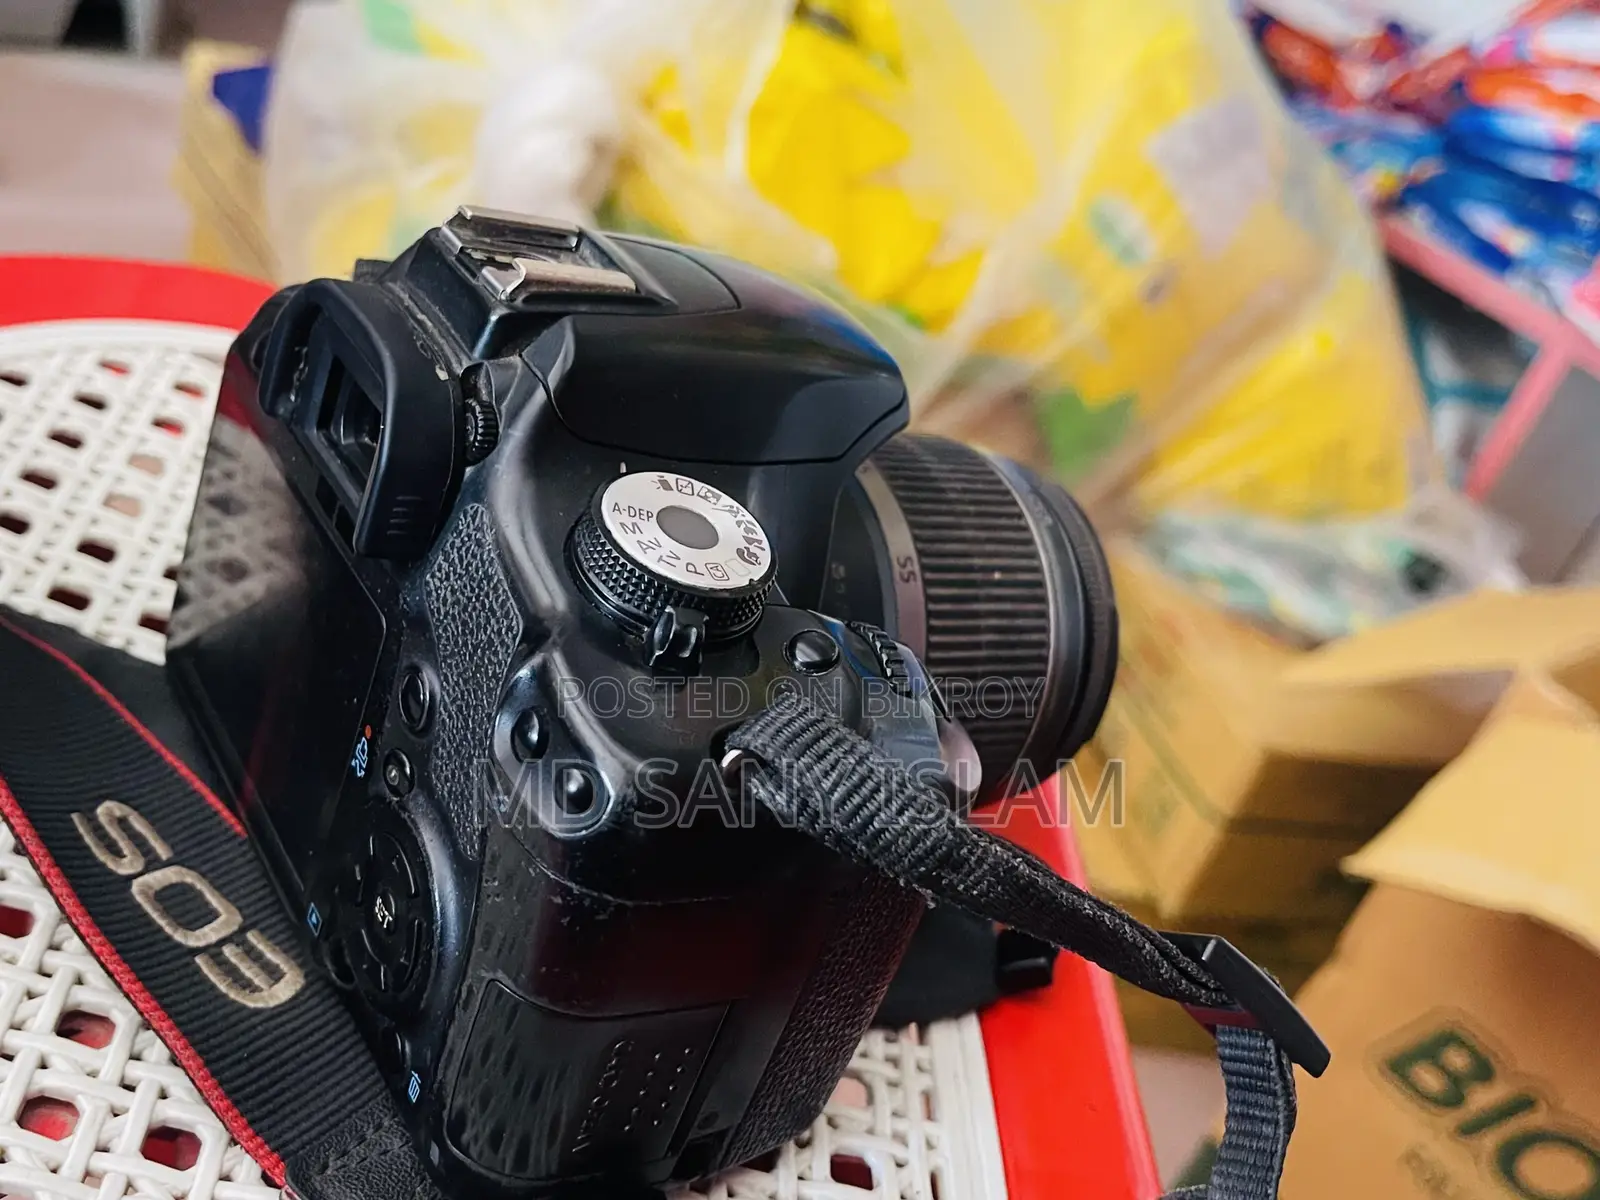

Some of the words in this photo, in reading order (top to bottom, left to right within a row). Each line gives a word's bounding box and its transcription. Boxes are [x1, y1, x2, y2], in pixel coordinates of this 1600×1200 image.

[612, 502, 654, 522] A-DEP
[619, 521, 643, 535] M
[636, 537, 663, 554] Av
[657, 551, 681, 568] Tv
[686, 563, 705, 576] P
[897, 556, 916, 584] 55
[71, 800, 304, 1008] EOS
